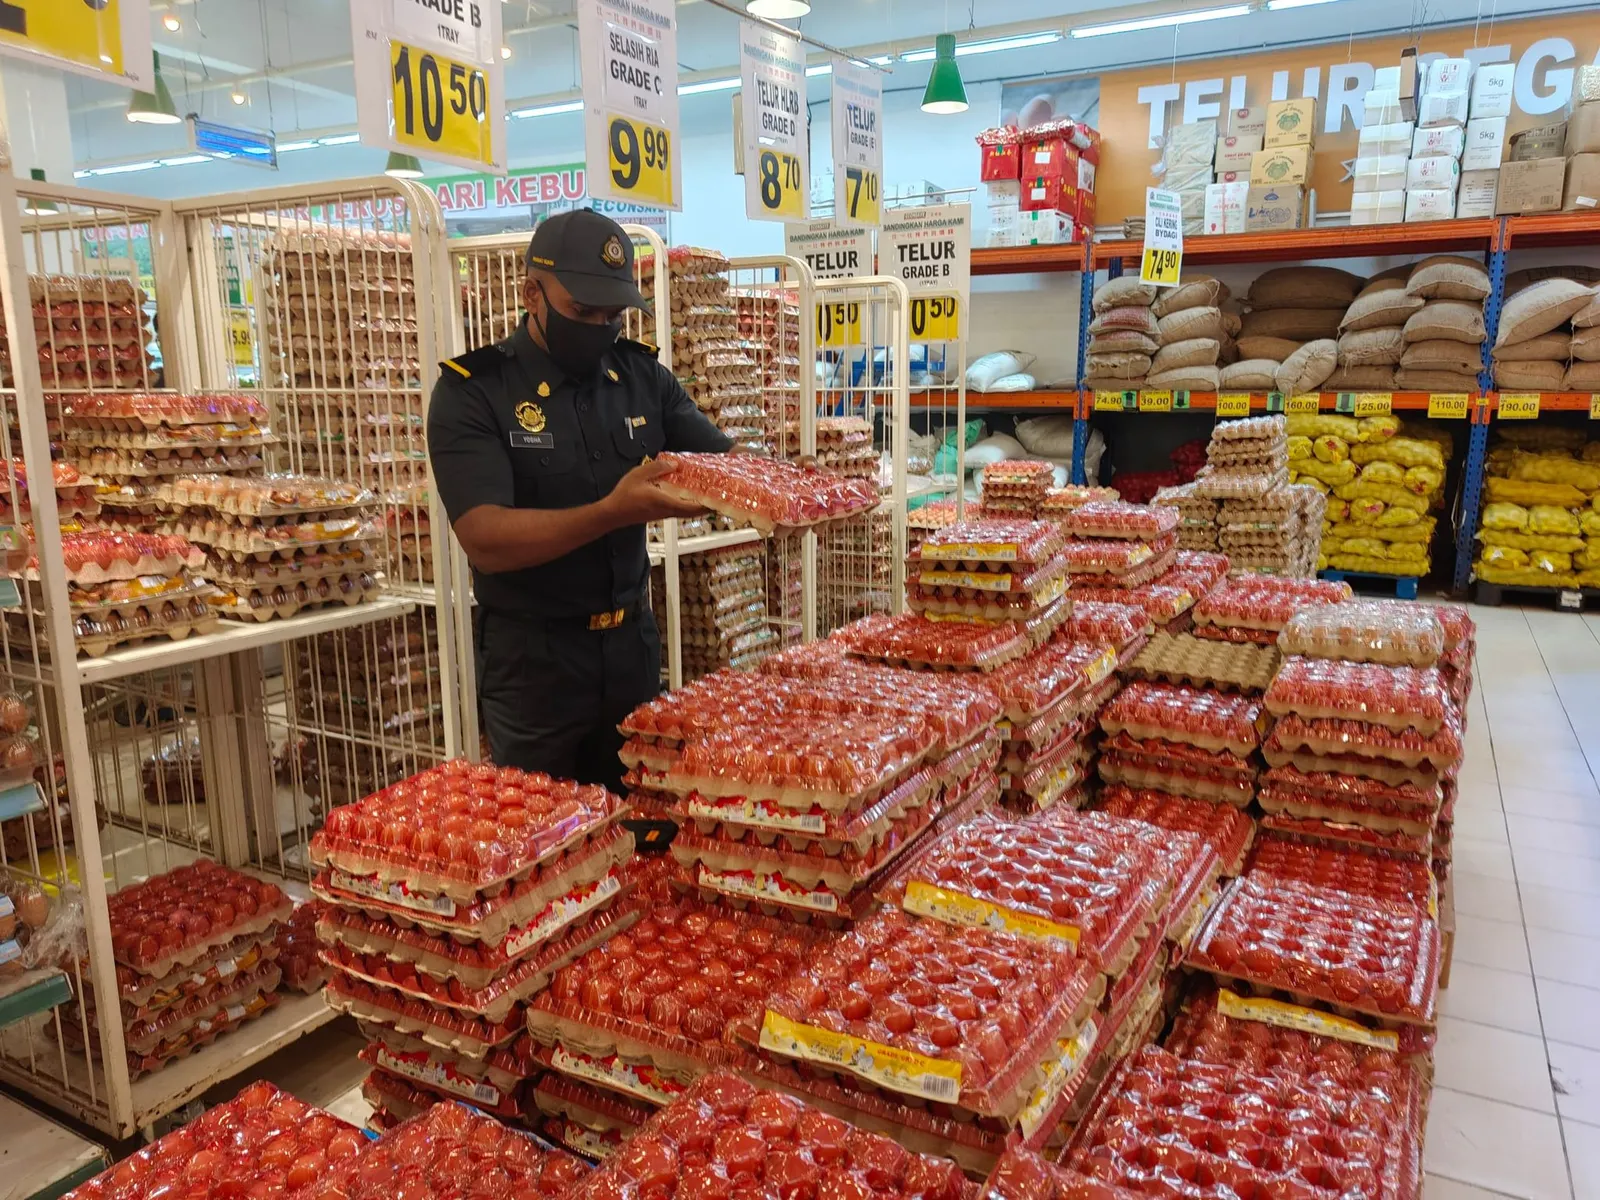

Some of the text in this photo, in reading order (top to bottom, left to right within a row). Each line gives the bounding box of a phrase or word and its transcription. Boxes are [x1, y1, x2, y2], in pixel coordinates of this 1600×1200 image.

[470, 3, 482, 28] B
[437, 23, 460, 44] 1TRAY
[609, 31, 660, 68] SELASIH RIA
[610, 59, 663, 96] GRADE C
[1488, 77, 1504, 87] 5kg
[394, 45, 486, 142] 10 50
[757, 79, 781, 109] TELUR
[762, 112, 796, 137] GRADE D
[847, 103, 876, 133] TELUR
[850, 131, 869, 148] GRADE
[1479, 130, 1495, 140] 5kg
[609, 118, 668, 190] 9 99
[437, 181, 485, 211] ARI
[495, 170, 587, 207] KEBU
[760, 151, 801, 210] 8 70
[846, 167, 878, 219] 7 10
[1155, 229, 1178, 240] BYDAGI
[805, 250, 858, 271] TELUR
[898, 240, 955, 262] TELUR
[902, 263, 950, 279] GRADE B
[1150, 249, 1177, 280] 74 90
[930, 297, 956, 318] 50
[1096, 396, 1122, 406] 74.90
[1140, 397, 1169, 406] 39.00
[1218, 402, 1247, 411] 100.00
[1286, 401, 1318, 411] 160.00
[1355, 401, 1390, 411] 125.00
[1435, 400, 1465, 410] 110.00
[1500, 402, 1536, 412] 190.00
